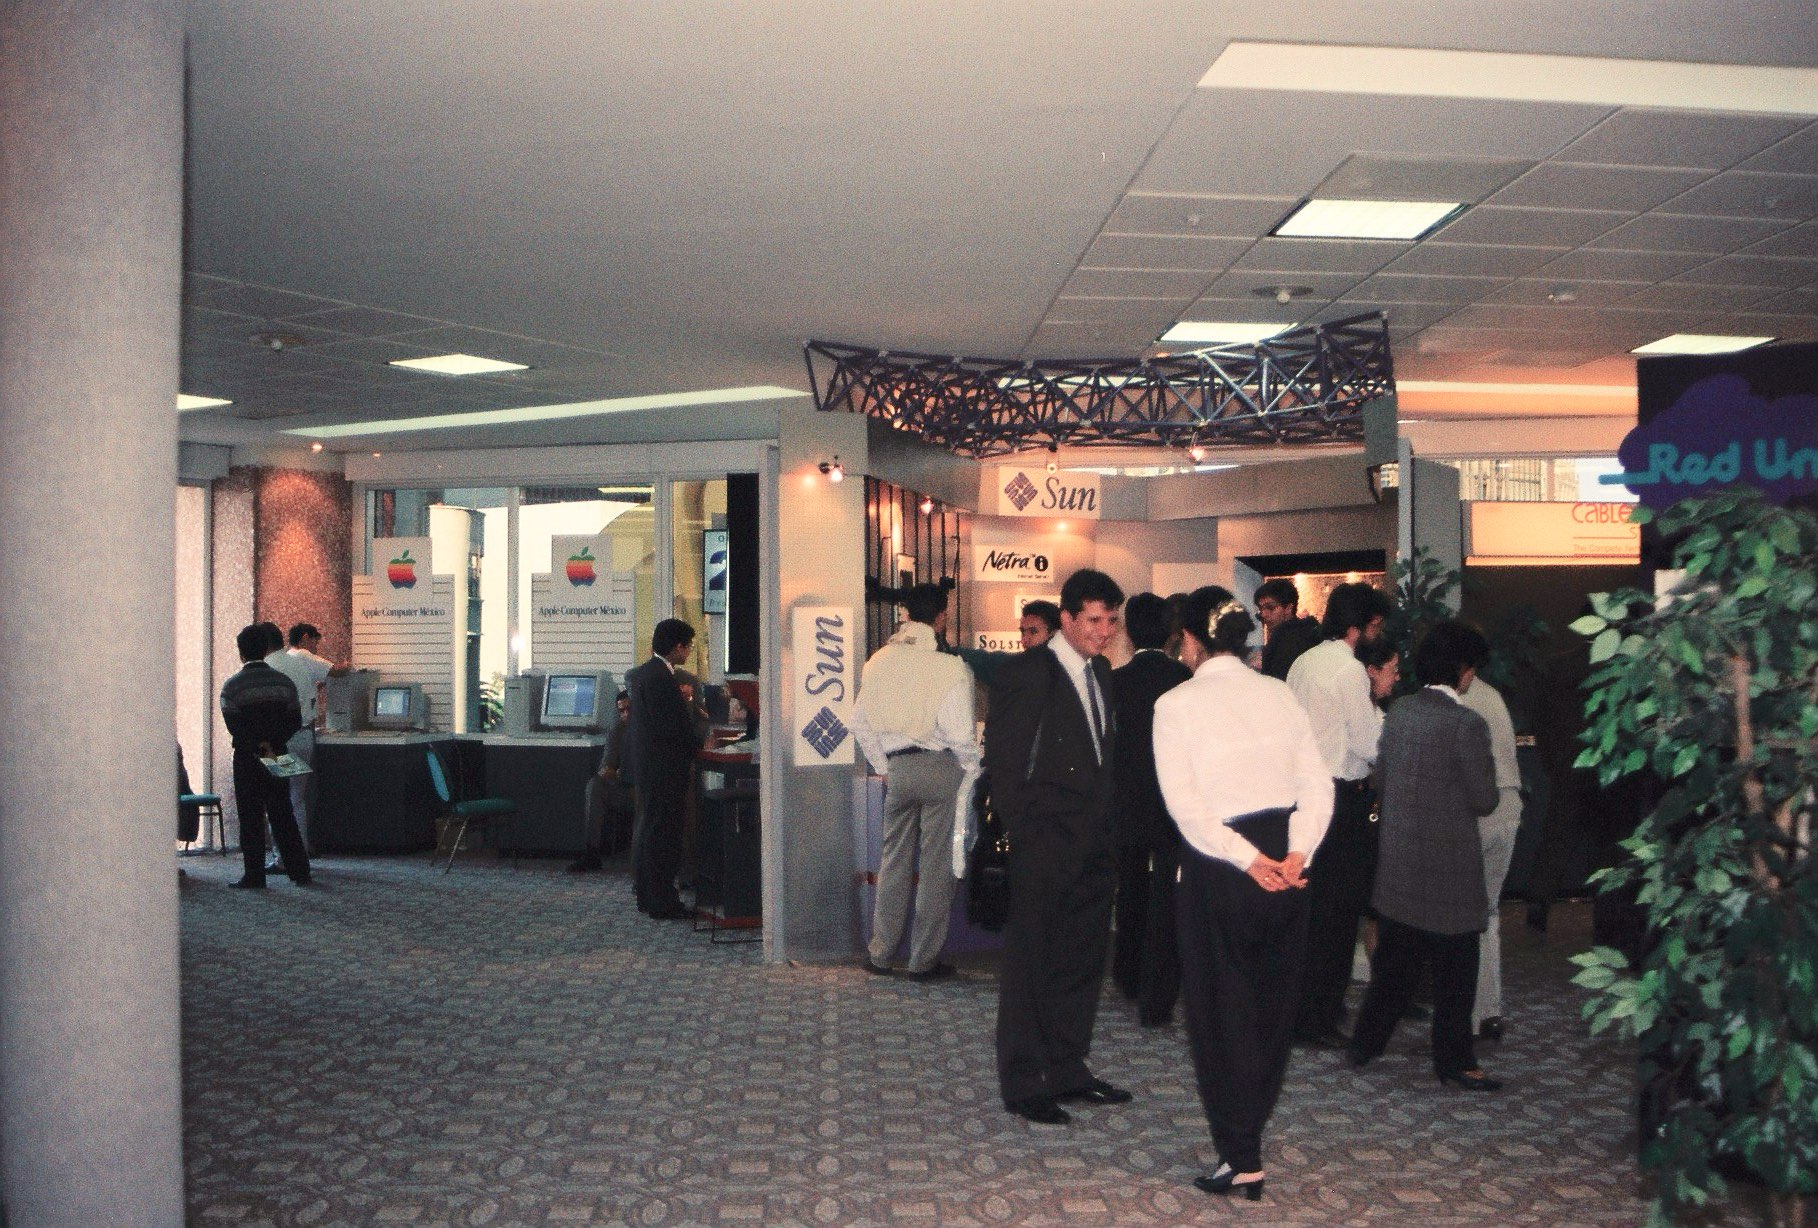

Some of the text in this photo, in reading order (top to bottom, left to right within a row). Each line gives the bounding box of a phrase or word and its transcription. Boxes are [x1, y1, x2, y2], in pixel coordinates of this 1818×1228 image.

[1648, 440, 1741, 485] Red
[1041, 476, 1097, 511] Sun
[982, 549, 1030, 572] Netra
[361, 606, 381, 619] Apple
[382, 606, 418, 619] Computer
[539, 605, 559, 618] Apple
[560, 605, 598, 618] Computer
[805, 614, 844, 702] Sun
